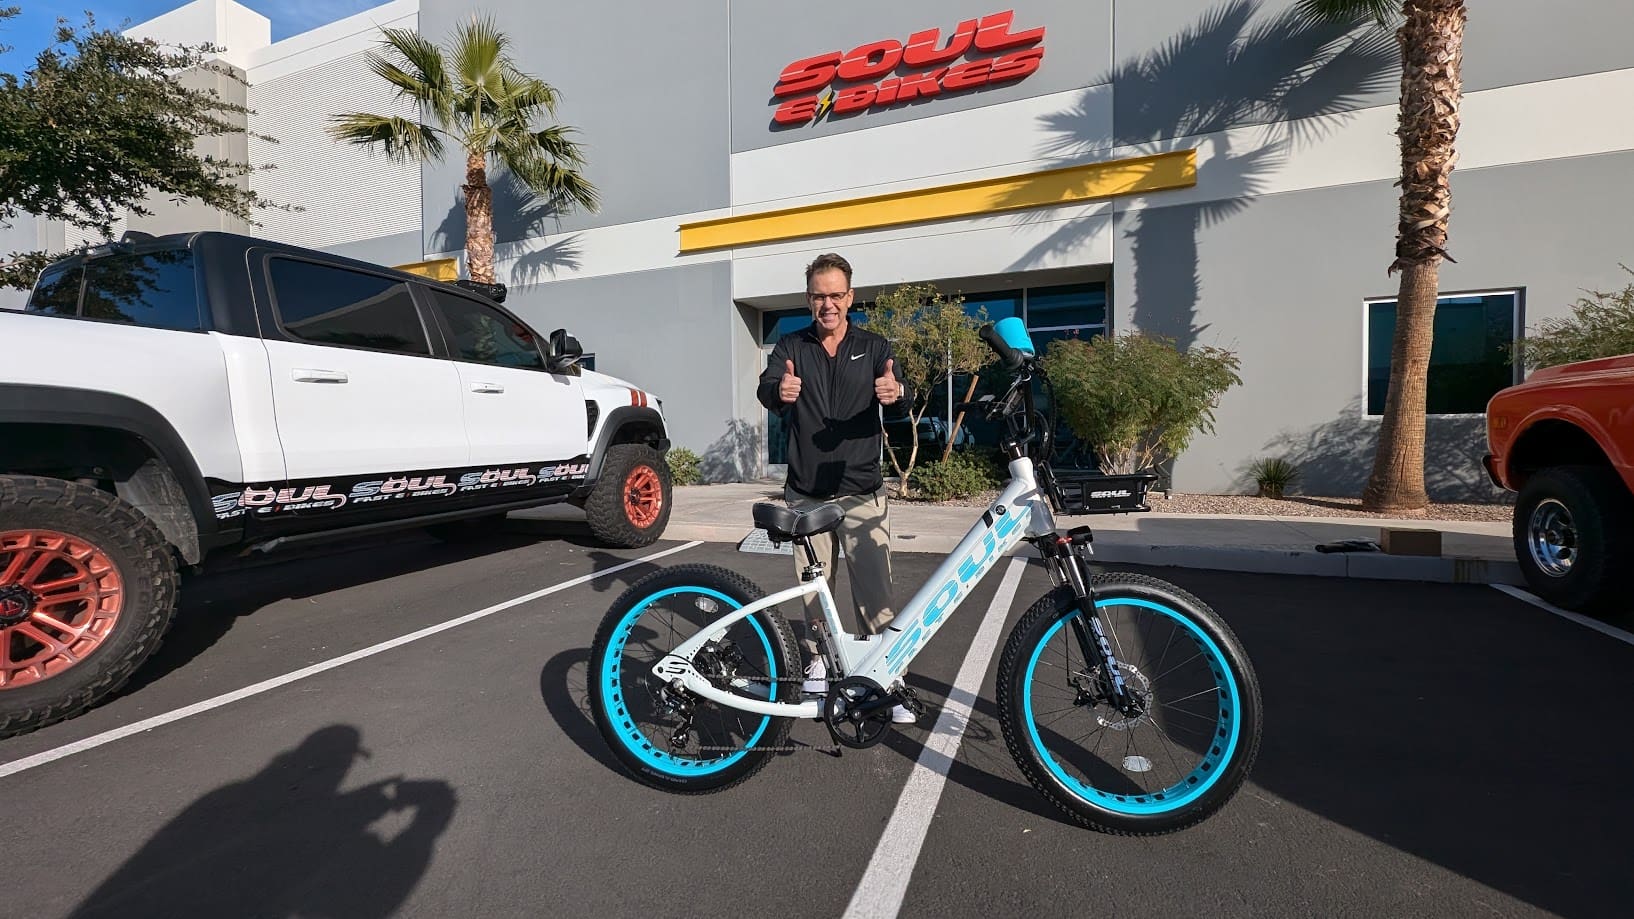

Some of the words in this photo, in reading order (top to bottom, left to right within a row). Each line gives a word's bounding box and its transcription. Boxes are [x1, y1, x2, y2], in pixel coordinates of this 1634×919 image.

[773, 10, 1046, 97] SOUL
[774, 95, 819, 125] E
[832, 47, 1045, 115] BIKES
[210, 485, 347, 513] SOUL
[348, 475, 457, 498] SOUL
[457, 468, 537, 487] SOUL
[885, 500, 1034, 676] SOUL
[1091, 617, 1125, 696] SOUL
